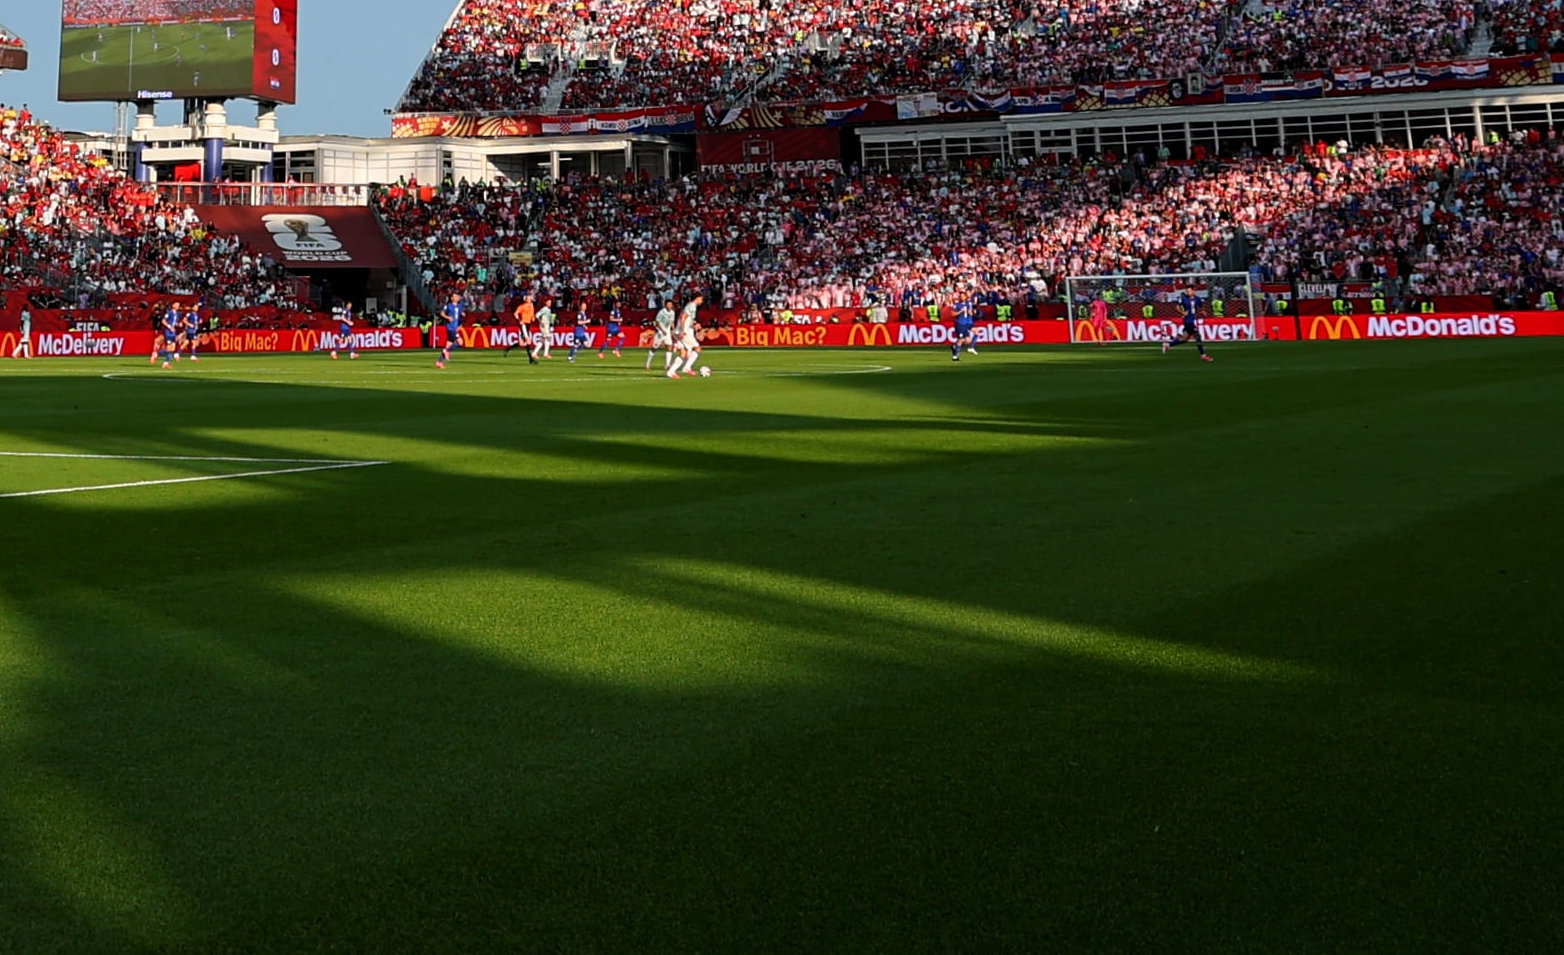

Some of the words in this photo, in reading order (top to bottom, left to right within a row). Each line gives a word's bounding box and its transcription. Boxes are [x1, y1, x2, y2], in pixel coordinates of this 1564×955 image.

[273, 7, 280, 24] 0
[272, 49, 280, 65] 0
[137, 90, 173, 99] Hisense
[285, 254, 353, 262] 2026
[76, 322, 100, 332] FIFA
[737, 325, 768, 346] Big
[774, 325, 827, 346] Mac?
[898, 323, 1024, 344] McDoald's
[1127, 319, 1253, 341] McDivery
[1367, 314, 1516, 337] McDonald's
[38, 331, 124, 356] McDelivery
[220, 332, 242, 352] Big
[245, 331, 278, 351] Mac?
